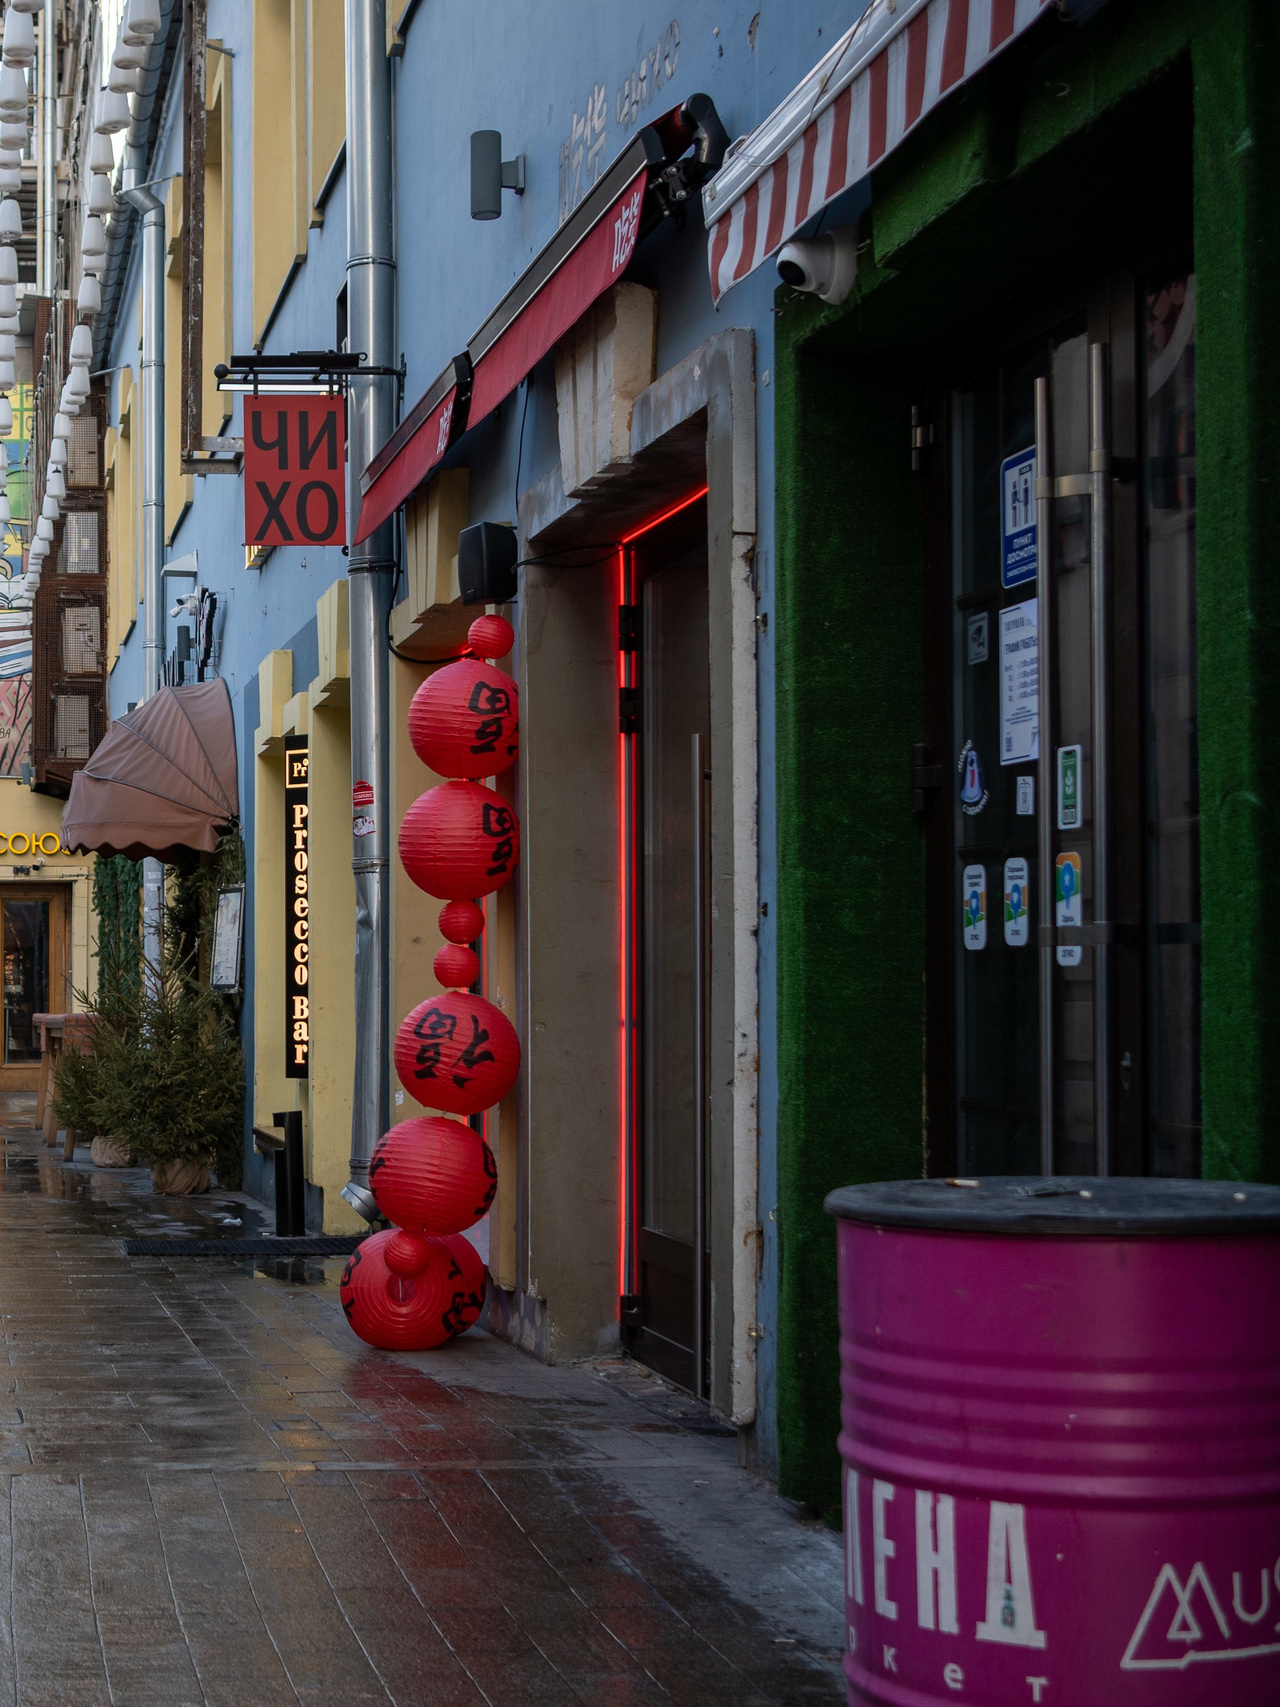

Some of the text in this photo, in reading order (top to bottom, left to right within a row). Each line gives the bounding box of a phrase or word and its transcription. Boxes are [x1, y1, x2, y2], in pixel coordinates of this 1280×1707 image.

[251, 410, 338, 471] ЧИ
[253, 480, 339, 542] ХО
[292, 804, 310, 1064] Prosecco Bar
